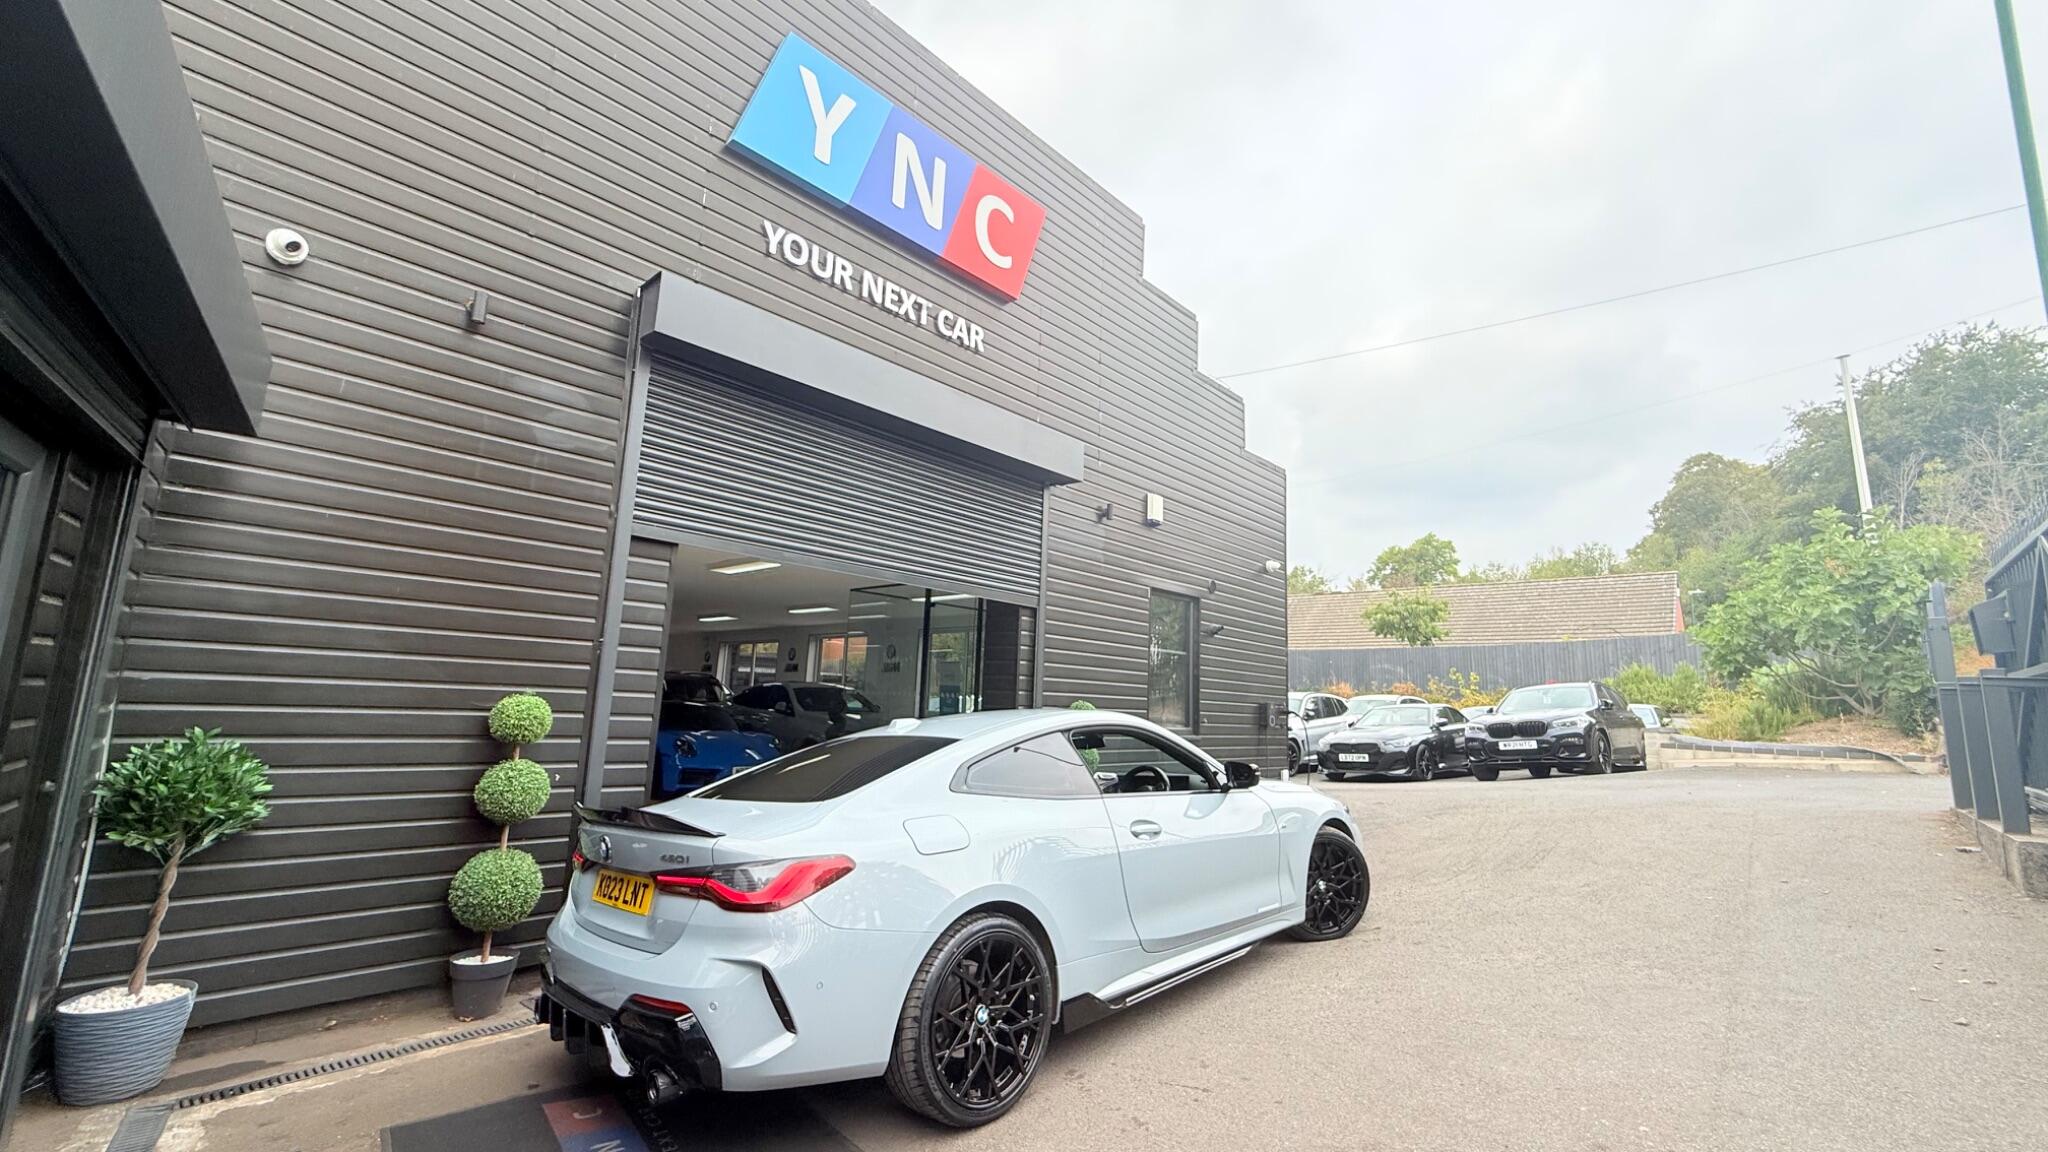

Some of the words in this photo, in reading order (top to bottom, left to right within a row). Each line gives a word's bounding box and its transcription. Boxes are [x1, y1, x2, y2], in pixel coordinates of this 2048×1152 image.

[763, 219, 853, 291] YOUR
[862, 270, 933, 326] NEXT
[937, 308, 985, 353] CAR
[622, 880, 649, 909] LNT
